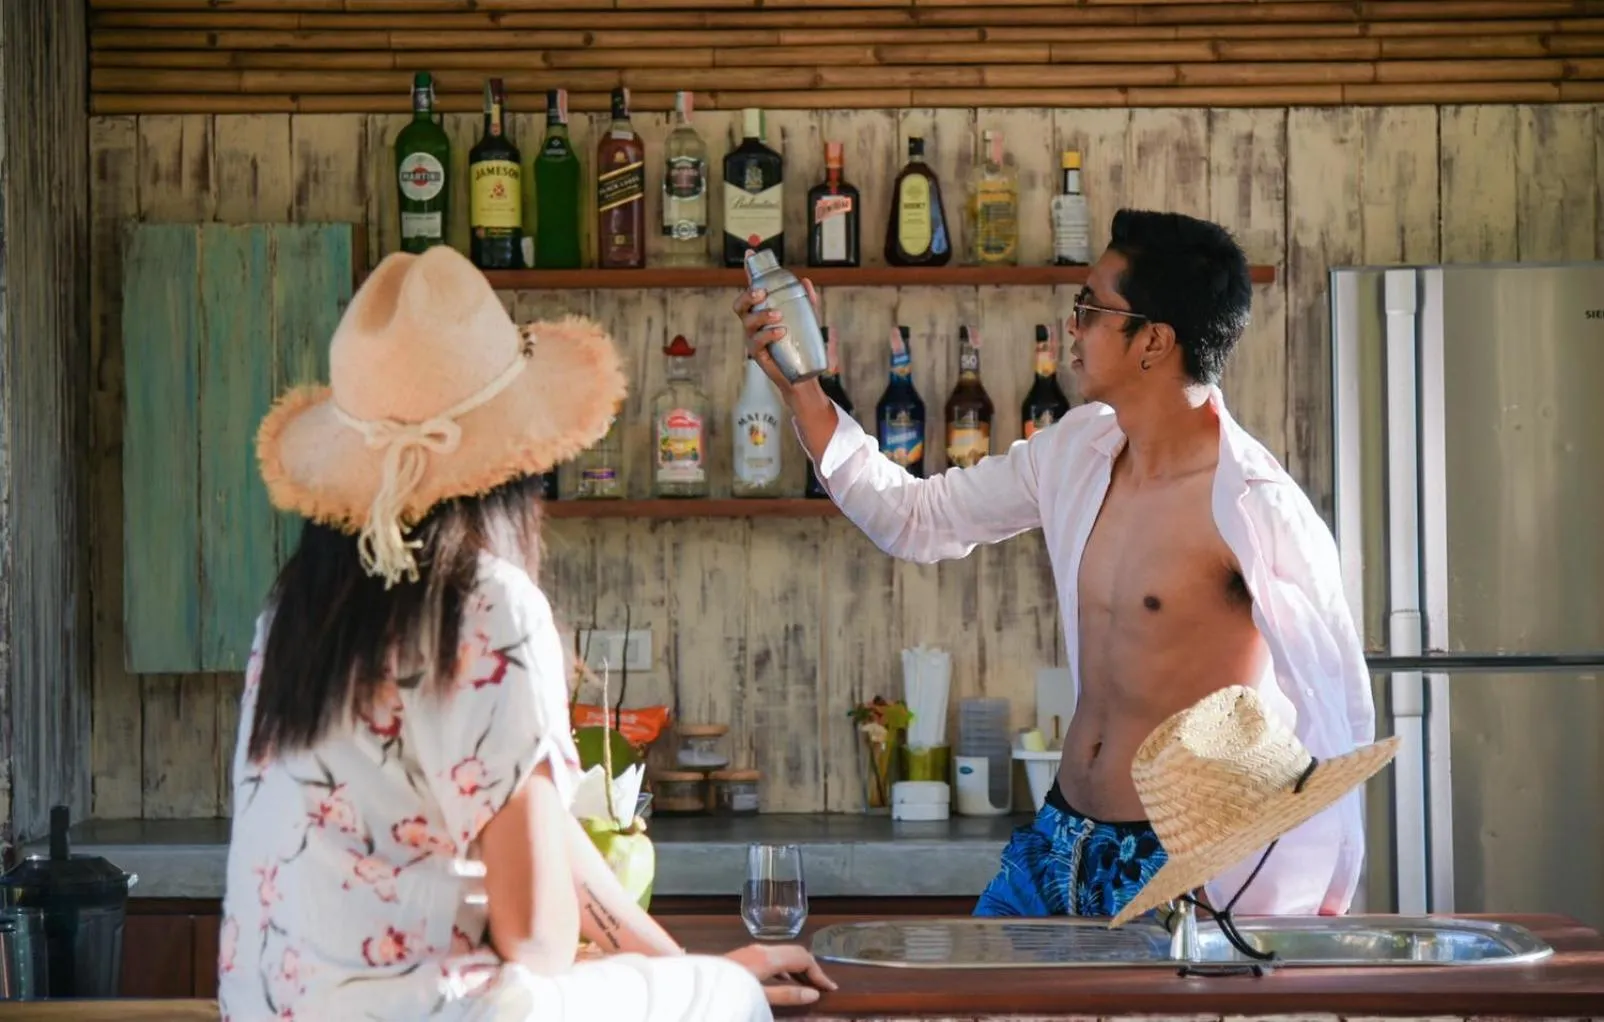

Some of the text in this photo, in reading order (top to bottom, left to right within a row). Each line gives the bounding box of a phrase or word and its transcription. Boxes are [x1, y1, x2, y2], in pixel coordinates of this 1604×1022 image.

[402, 172, 440, 182] MARTINI
[475, 165, 520, 181] JAMESON
[1585, 310, 1604, 319] SIE
